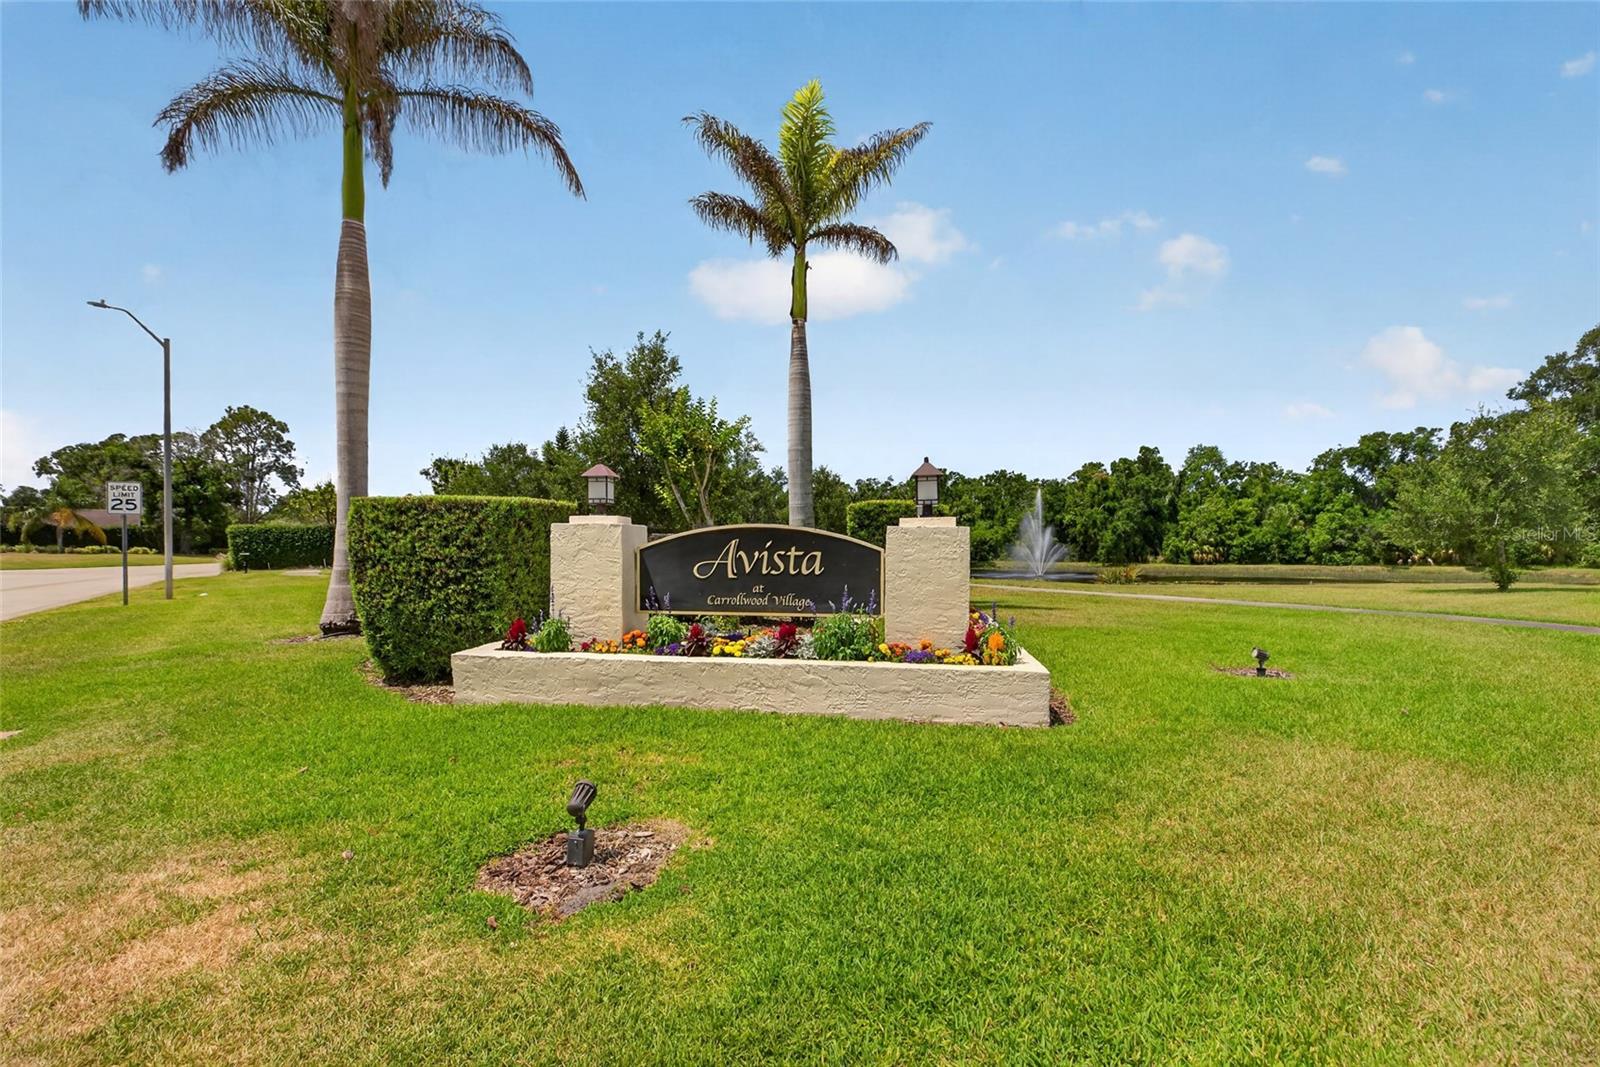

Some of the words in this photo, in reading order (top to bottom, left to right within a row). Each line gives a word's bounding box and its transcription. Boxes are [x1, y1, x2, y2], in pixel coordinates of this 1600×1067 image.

[111, 498, 137, 511] 25
[693, 538, 825, 579] Avista
[752, 584, 764, 593] at
[707, 592, 769, 606] Carrollwood
[772, 594, 811, 611] Village
